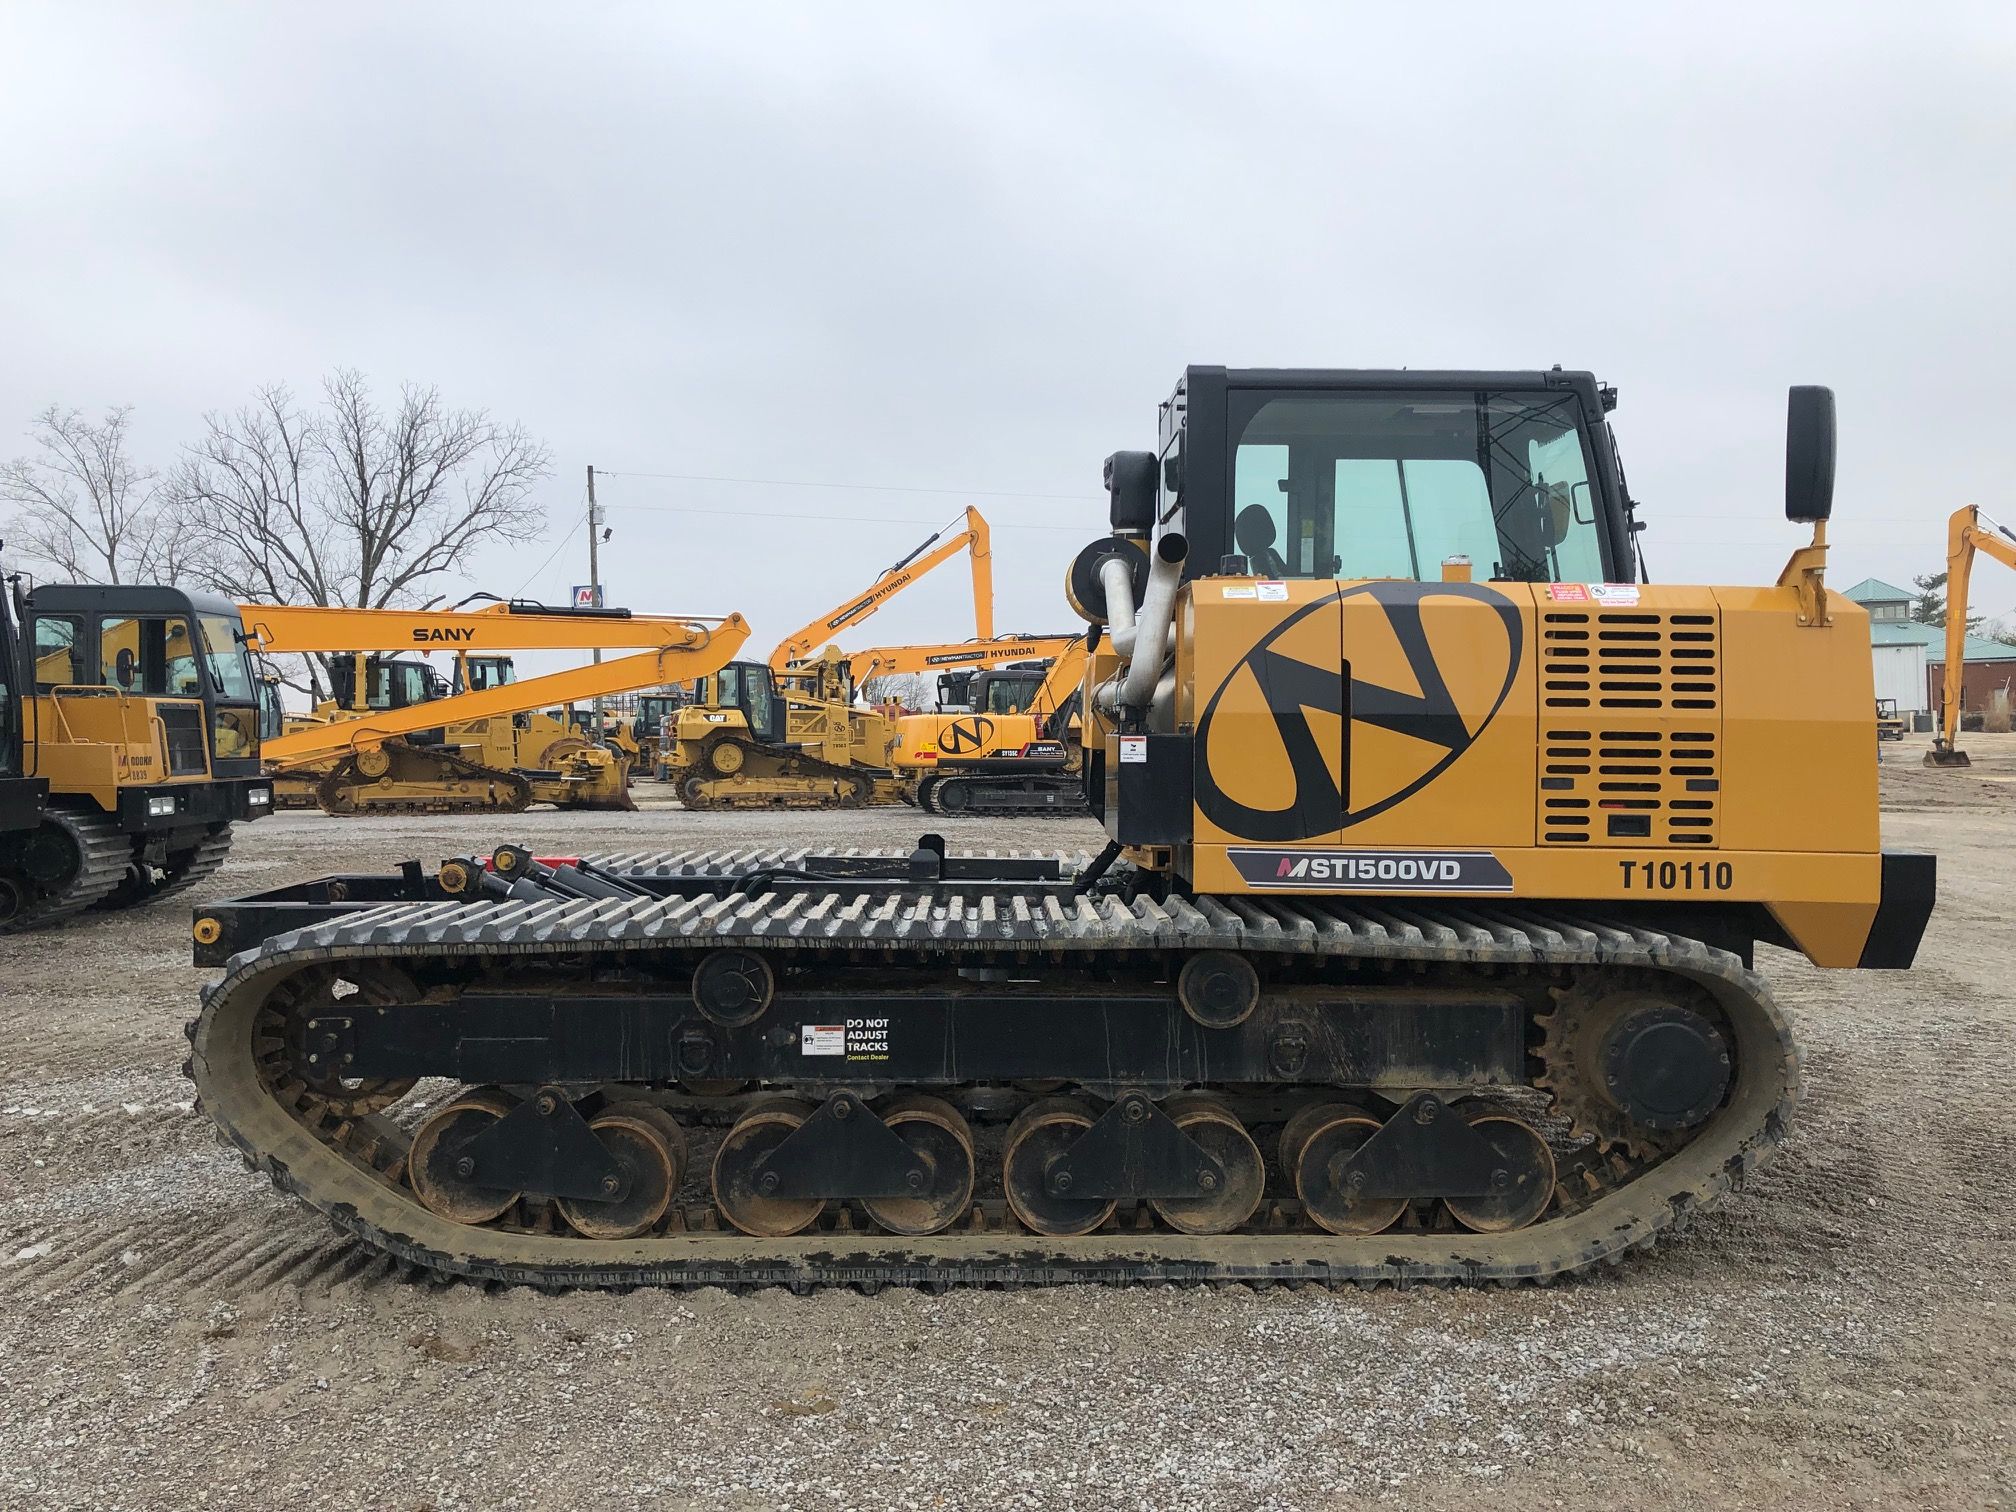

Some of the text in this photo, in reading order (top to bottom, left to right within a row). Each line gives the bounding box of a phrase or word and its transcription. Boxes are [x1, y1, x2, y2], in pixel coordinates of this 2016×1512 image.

[875, 574, 911, 599] HYUNDAI
[413, 628, 475, 641] SANY
[991, 647, 1035, 658] HYUNDAI
[1619, 861, 1733, 890] T10110
[846, 1019, 889, 1028] DO NOT
[847, 1031, 888, 1040] ADJUST
[847, 1042, 888, 1051] TRACKS
